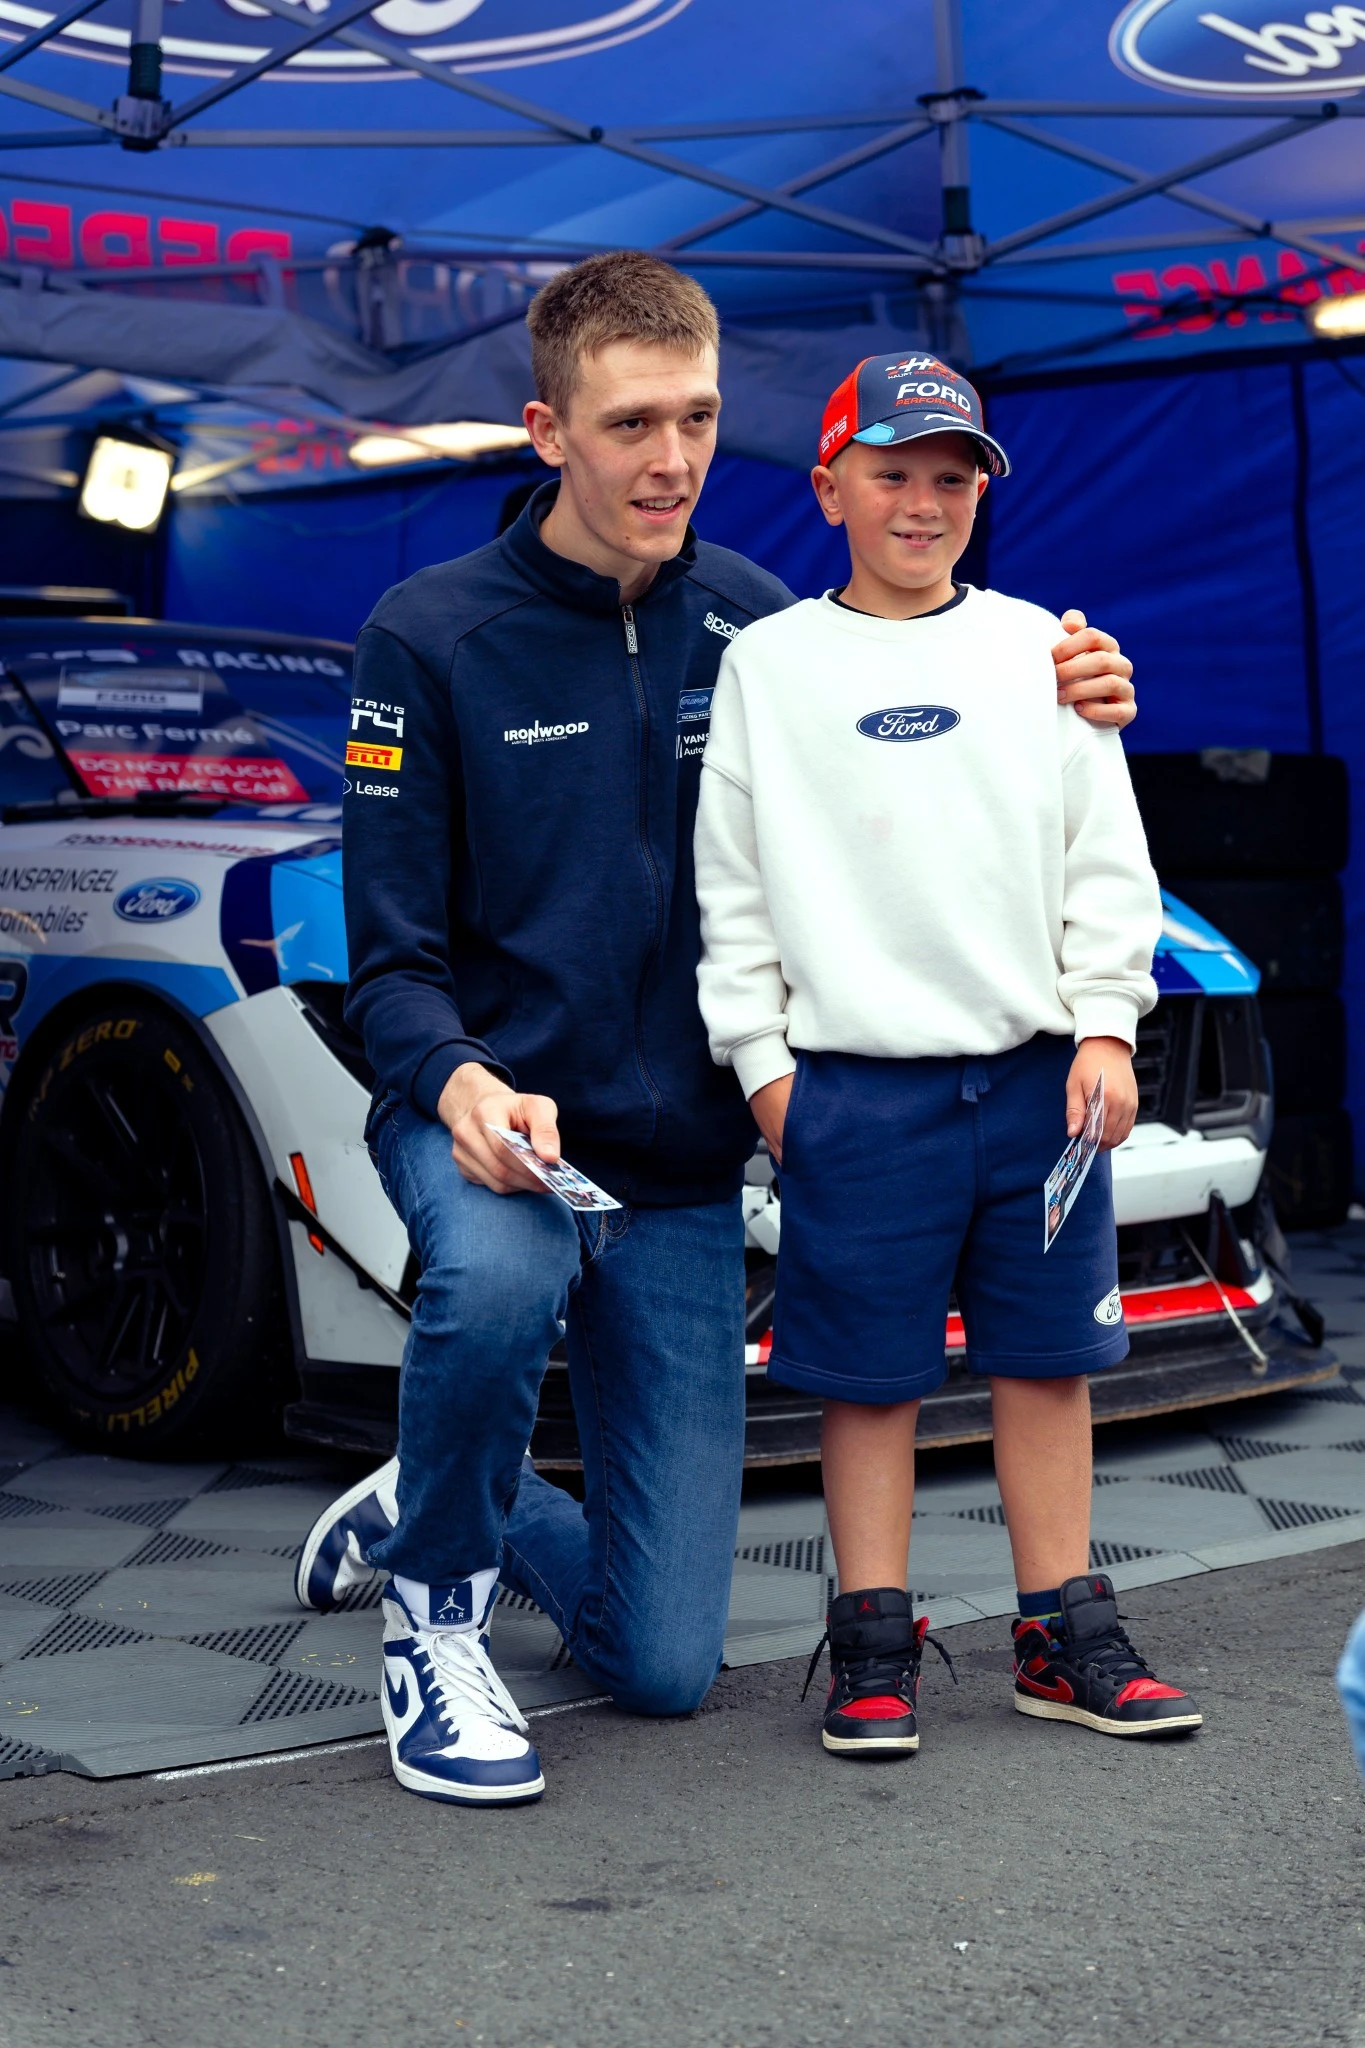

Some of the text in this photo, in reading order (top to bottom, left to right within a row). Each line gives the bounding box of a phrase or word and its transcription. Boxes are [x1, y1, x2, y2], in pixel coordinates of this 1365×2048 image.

[897, 382, 971, 412] FORD
[178, 650, 345, 677] RACING
[352, 698, 405, 715] TANG
[56, 720, 255, 744] Parc Fermé
[504, 720, 589, 745] IRONWOOD
[877, 710, 940, 736] Ford
[79, 758, 284, 779] DO NOT TOUCH
[95, 775, 291, 797] THE RACE CAR
[356, 780, 399, 798] Lease
[123, 885, 184, 916] Ford
[59, 1019, 138, 1073] ZERO
[107, 1348, 200, 1432] PIRELLI
